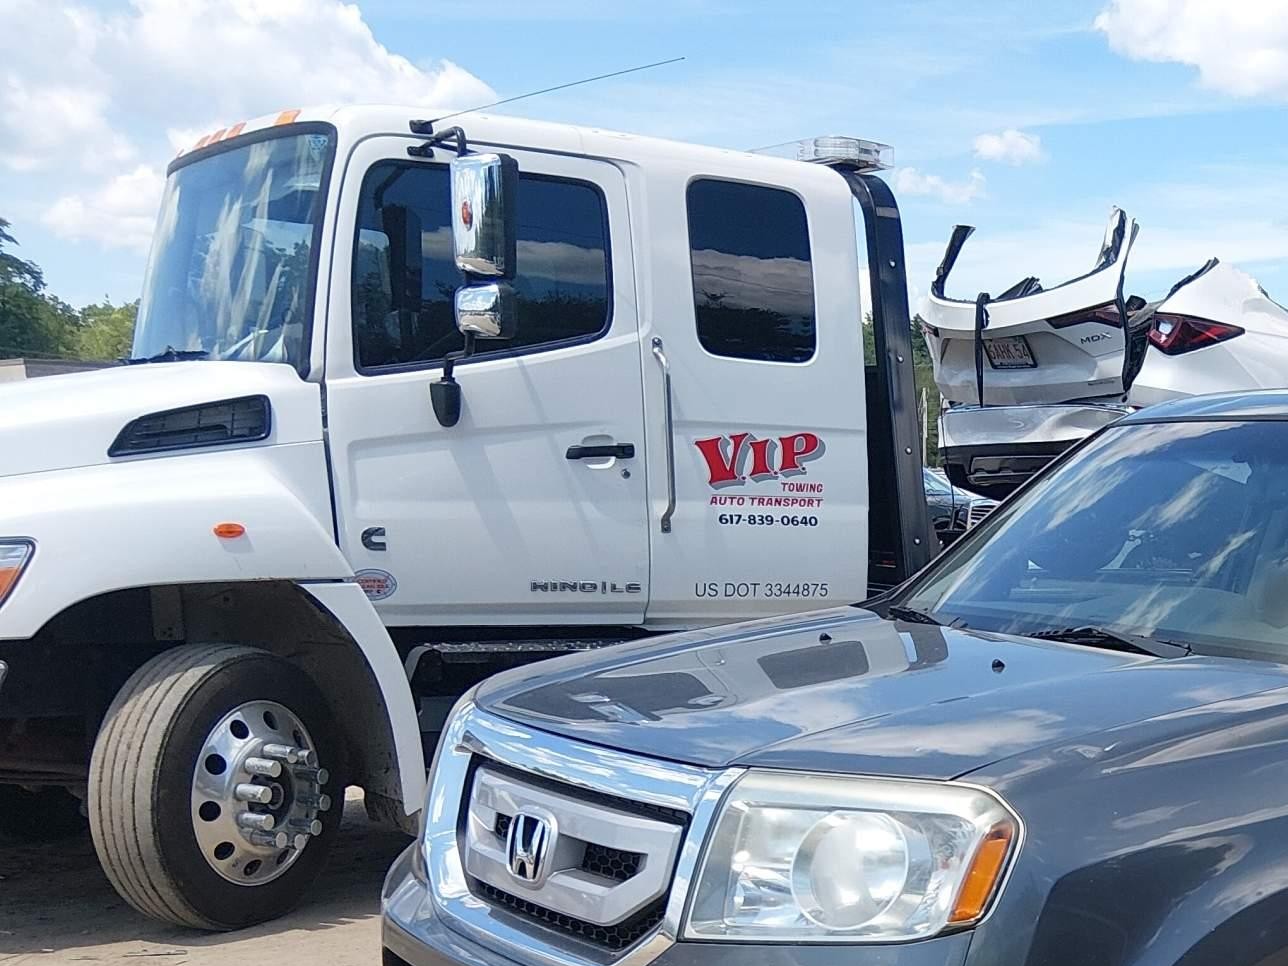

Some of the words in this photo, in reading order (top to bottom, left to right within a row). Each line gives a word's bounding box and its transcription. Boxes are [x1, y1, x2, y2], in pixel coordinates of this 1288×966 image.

[1080, 332, 1112, 344] MDX
[781, 481, 823, 494] TOWING
[709, 496, 745, 506] AUTO
[748, 496, 824, 508] TRANSPORT
[718, 513, 819, 527] 617-839-0640
[694, 582, 719, 598] US
[724, 582, 761, 598] DOT
[764, 582, 829, 598] 3344875
